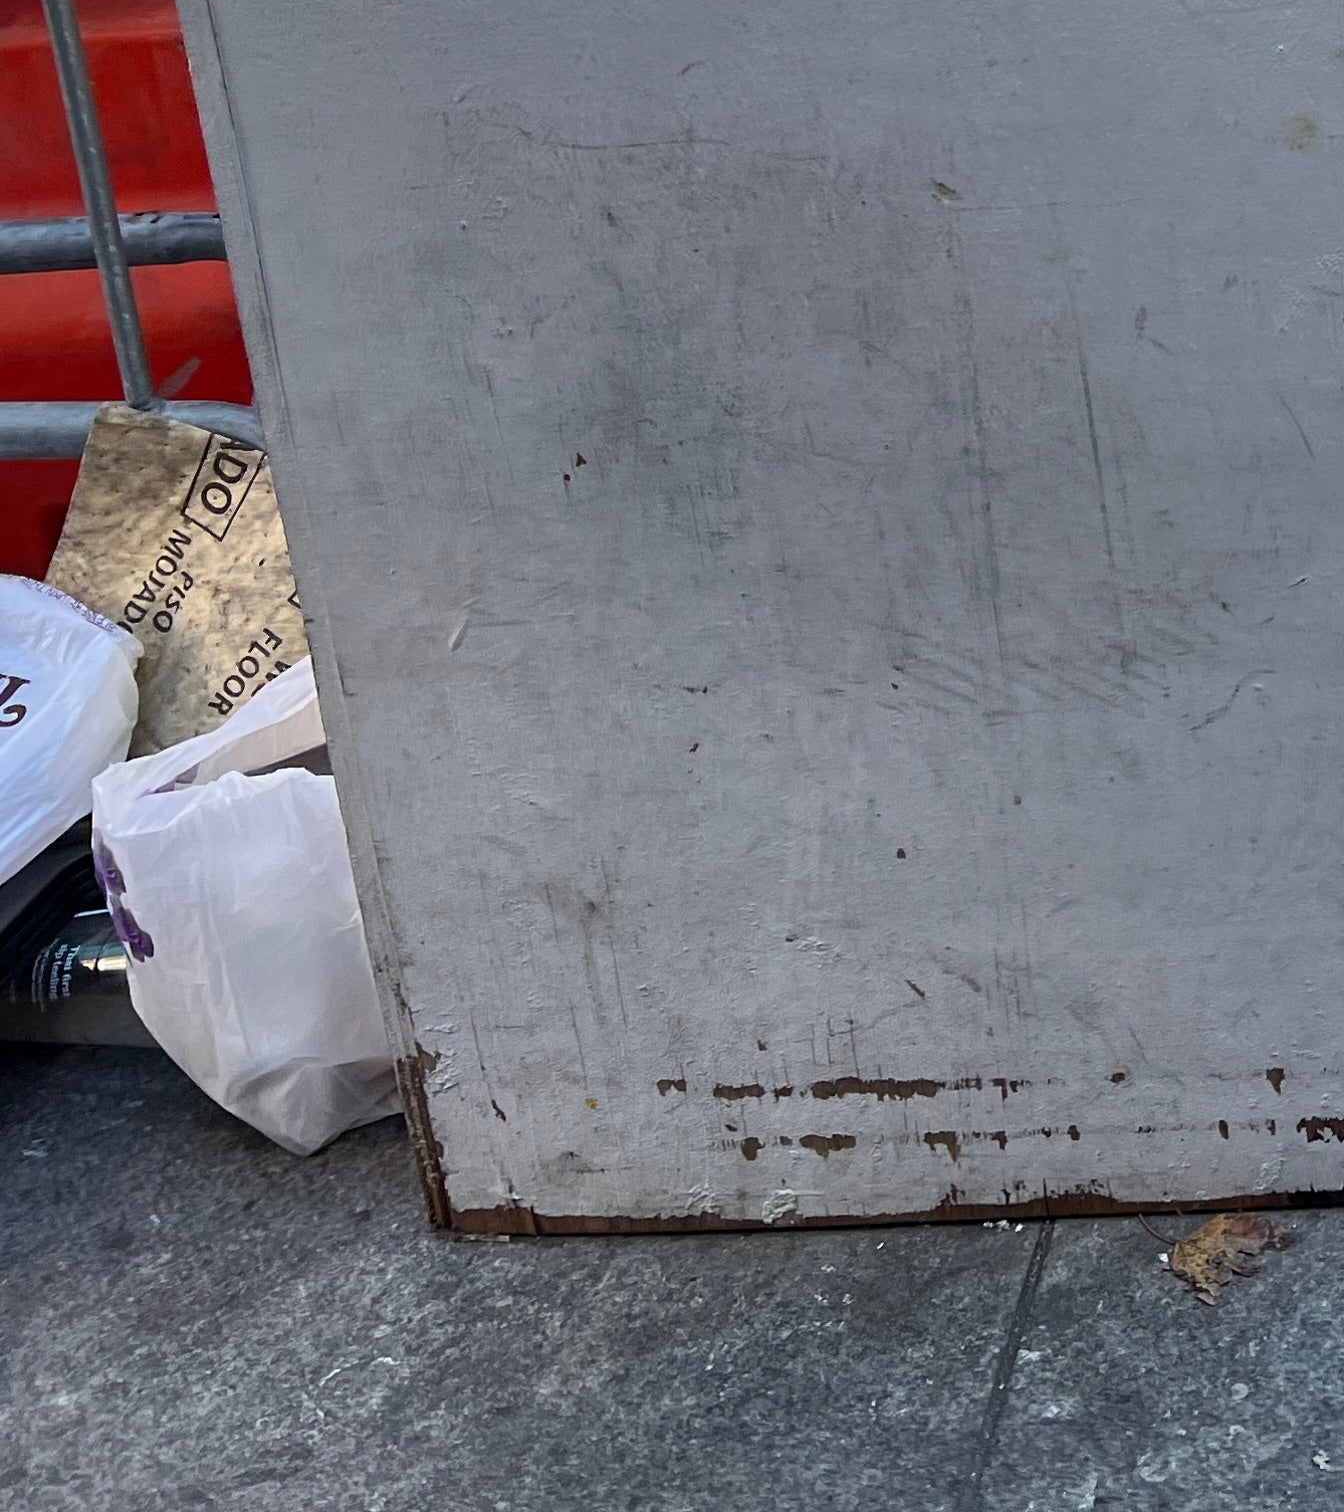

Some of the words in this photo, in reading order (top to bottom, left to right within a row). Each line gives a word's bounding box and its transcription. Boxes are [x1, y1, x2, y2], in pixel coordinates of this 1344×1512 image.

[153, 571, 194, 633] PISO
[207, 628, 283, 716] FLOOR
[64, 945, 81, 971] That
